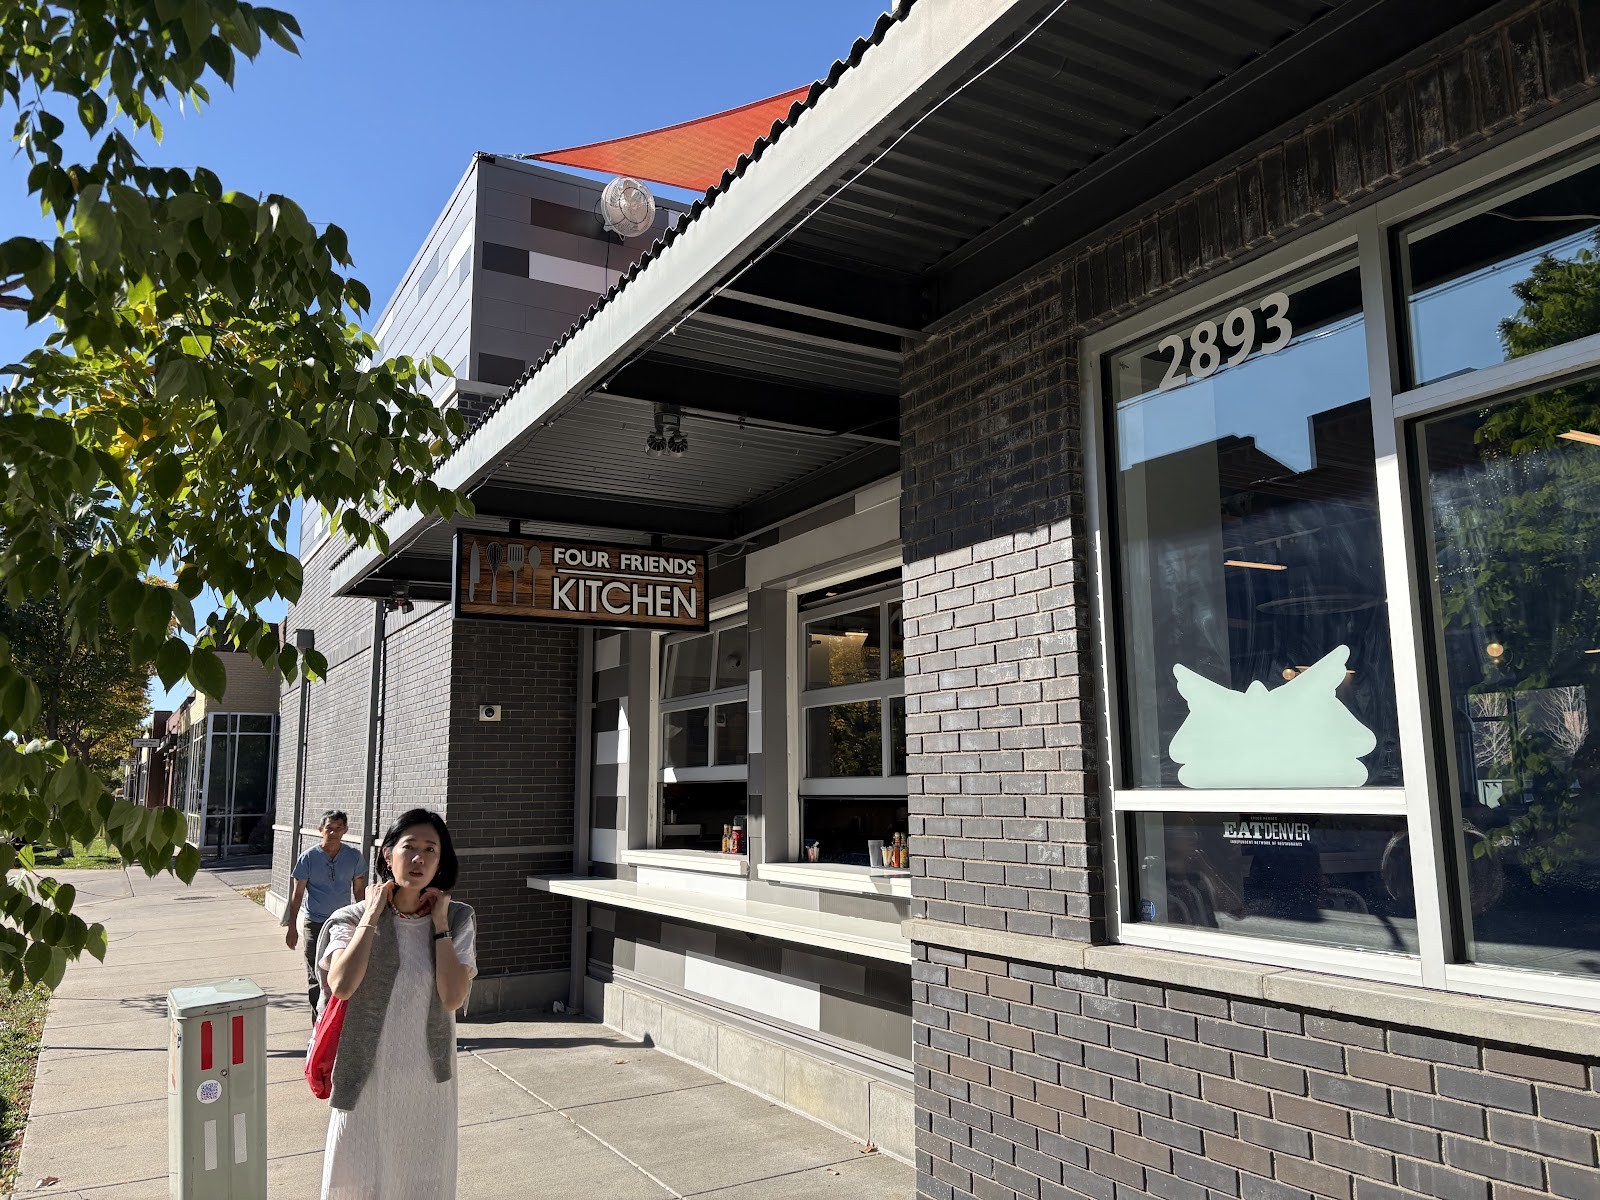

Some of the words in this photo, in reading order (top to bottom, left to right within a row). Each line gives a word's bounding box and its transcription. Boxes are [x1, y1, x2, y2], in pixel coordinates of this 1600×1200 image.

[1158, 292, 1292, 392] 2893
[553, 548, 610, 569] FOUR
[620, 554, 696, 575] FRIENDS
[553, 577, 697, 618] KITCHEN
